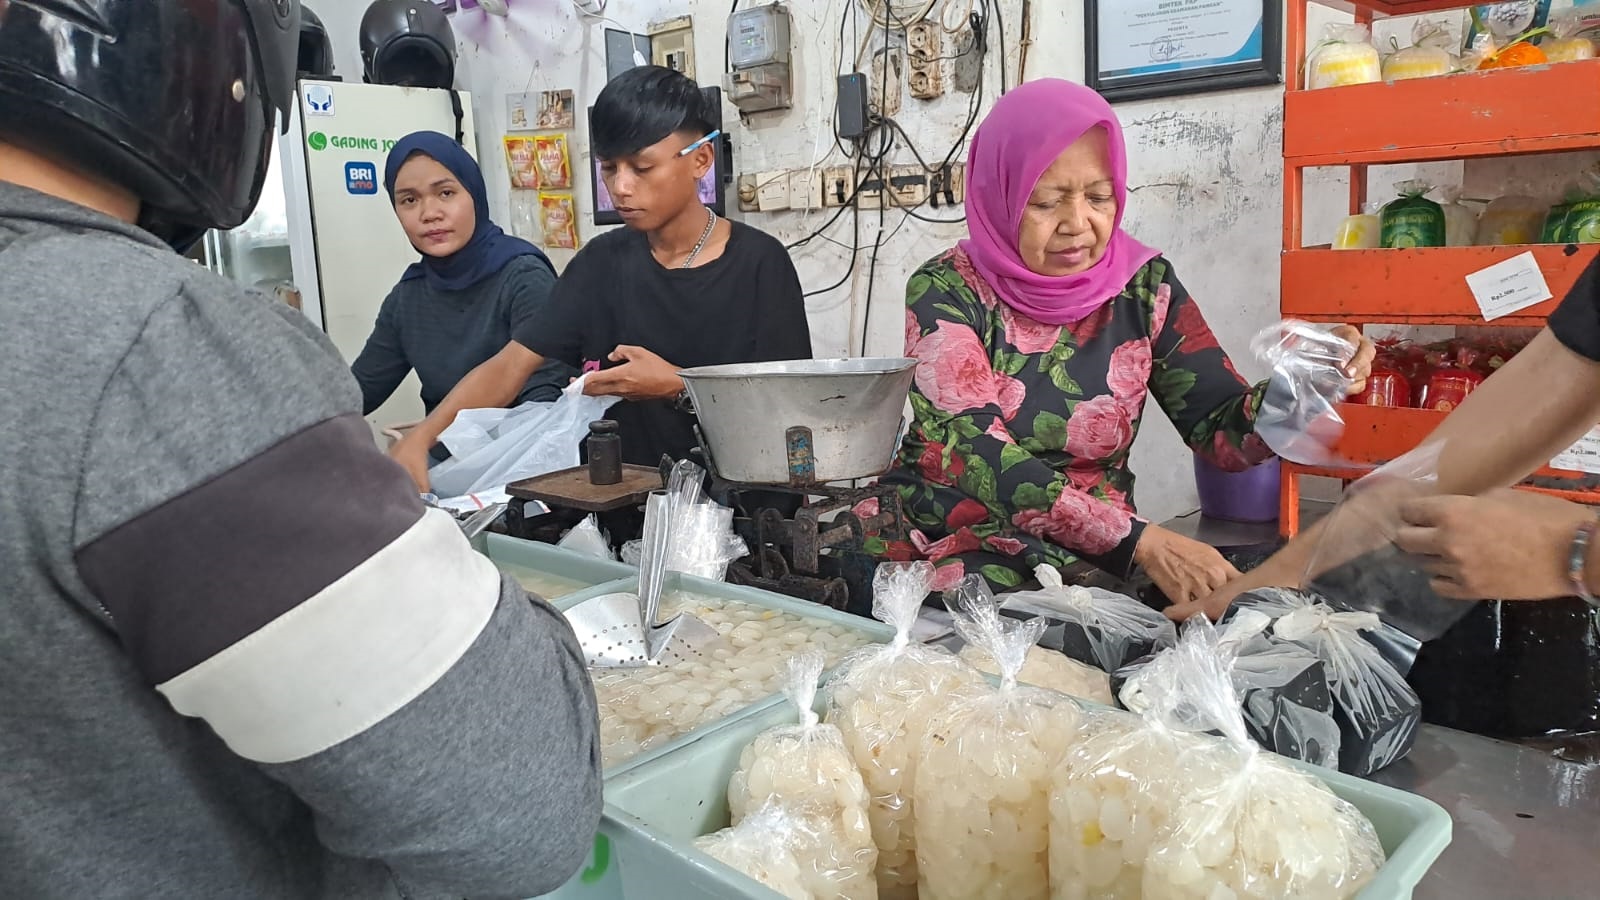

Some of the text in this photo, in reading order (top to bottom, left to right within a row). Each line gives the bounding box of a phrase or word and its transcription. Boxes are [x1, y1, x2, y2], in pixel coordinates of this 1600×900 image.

[330, 135, 398, 153] GADING JO
[349, 167, 373, 180] BRI
